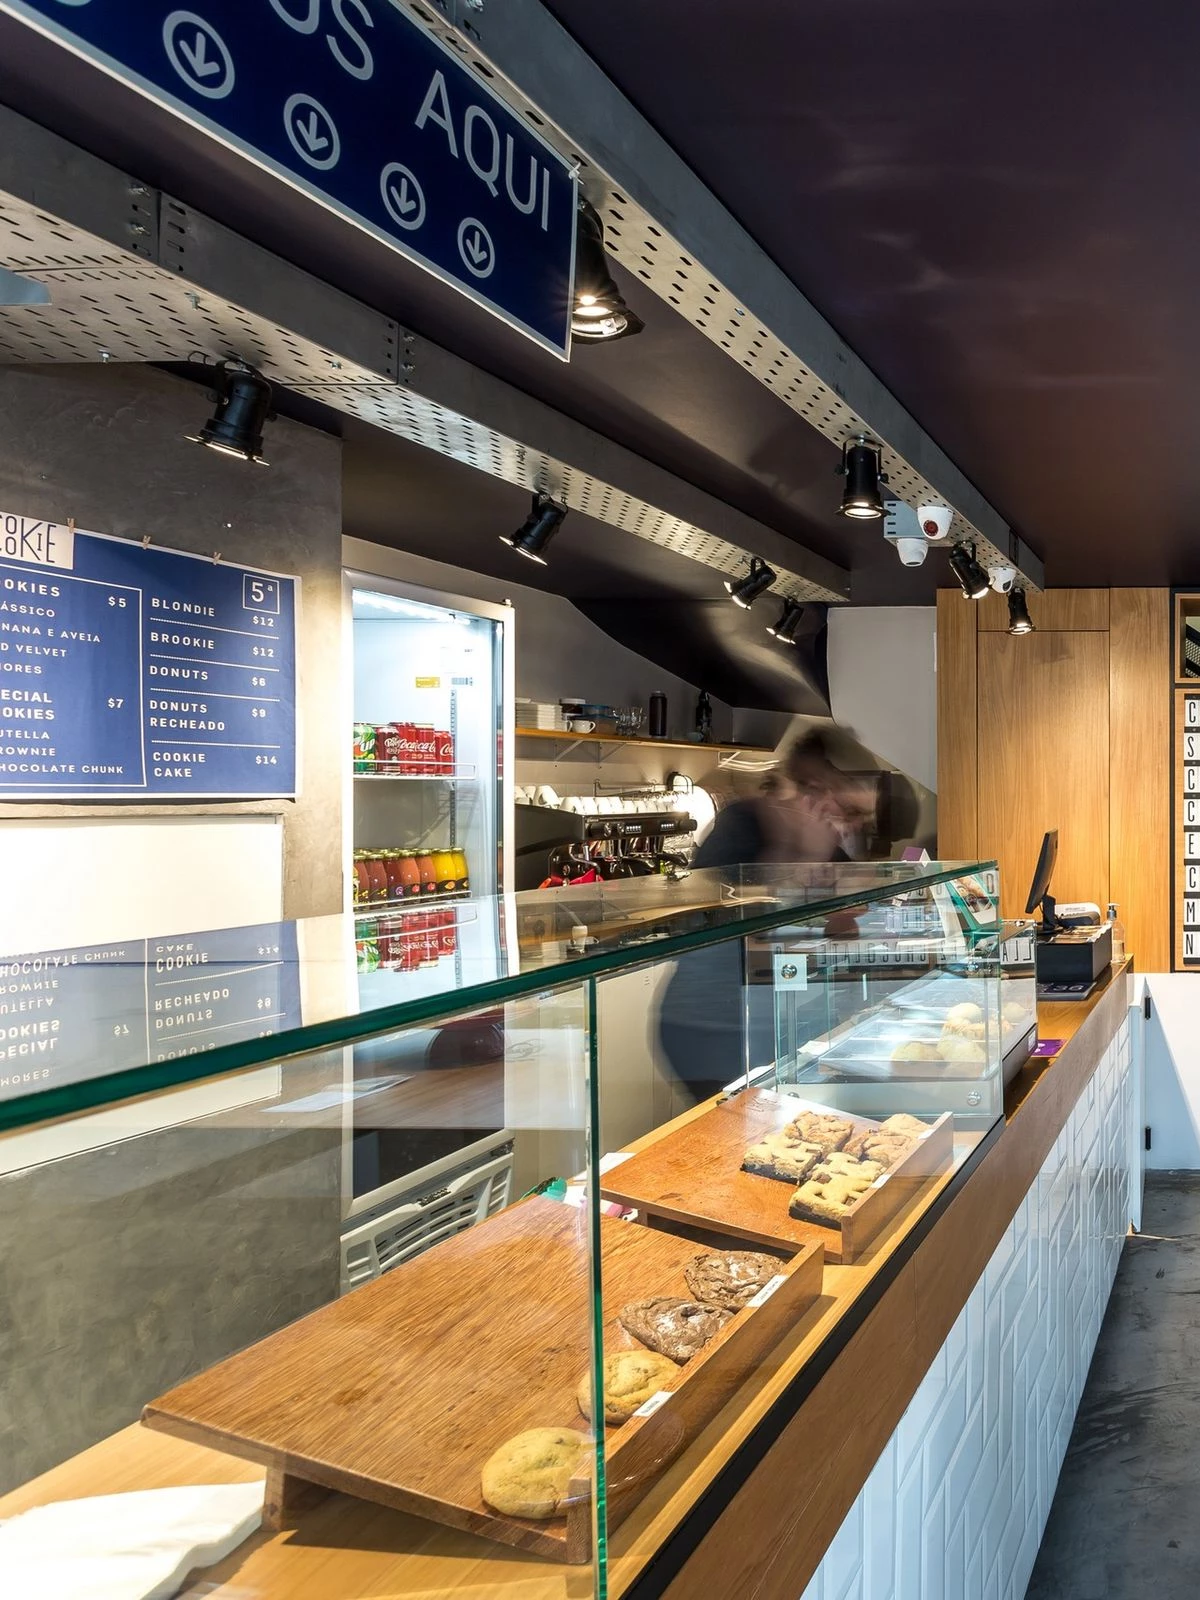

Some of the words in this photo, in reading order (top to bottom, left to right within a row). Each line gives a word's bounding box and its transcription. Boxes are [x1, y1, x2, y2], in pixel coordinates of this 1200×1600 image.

[415, 69, 550, 231] AQUI
[0, 577, 61, 597] OKIES
[108, 596, 127, 608] $5
[0, 600, 55, 618] ÁSSICO
[152, 597, 215, 617] BLONDIE
[252, 616, 275, 627] $12
[1, 622, 41, 635] NANA
[47, 629, 54, 637] E
[60, 631, 101, 643] AVEIA
[16, 644, 67, 657] VELVET
[150, 632, 215, 650] BROOKIE
[252, 646, 274, 658] $12
[0, 663, 42, 674] ORES
[149, 666, 209, 681] DONUTS
[1, 689, 53, 703] ECIAL
[108, 698, 124, 709] $7
[149, 700, 208, 714] DONUTS
[150, 718, 226, 731] RECHEADO
[153, 752, 206, 763] COOKIE
[256, 756, 277, 765] $14
[82, 765, 124, 774] CHUNK
[154, 768, 193, 778] CAKE
